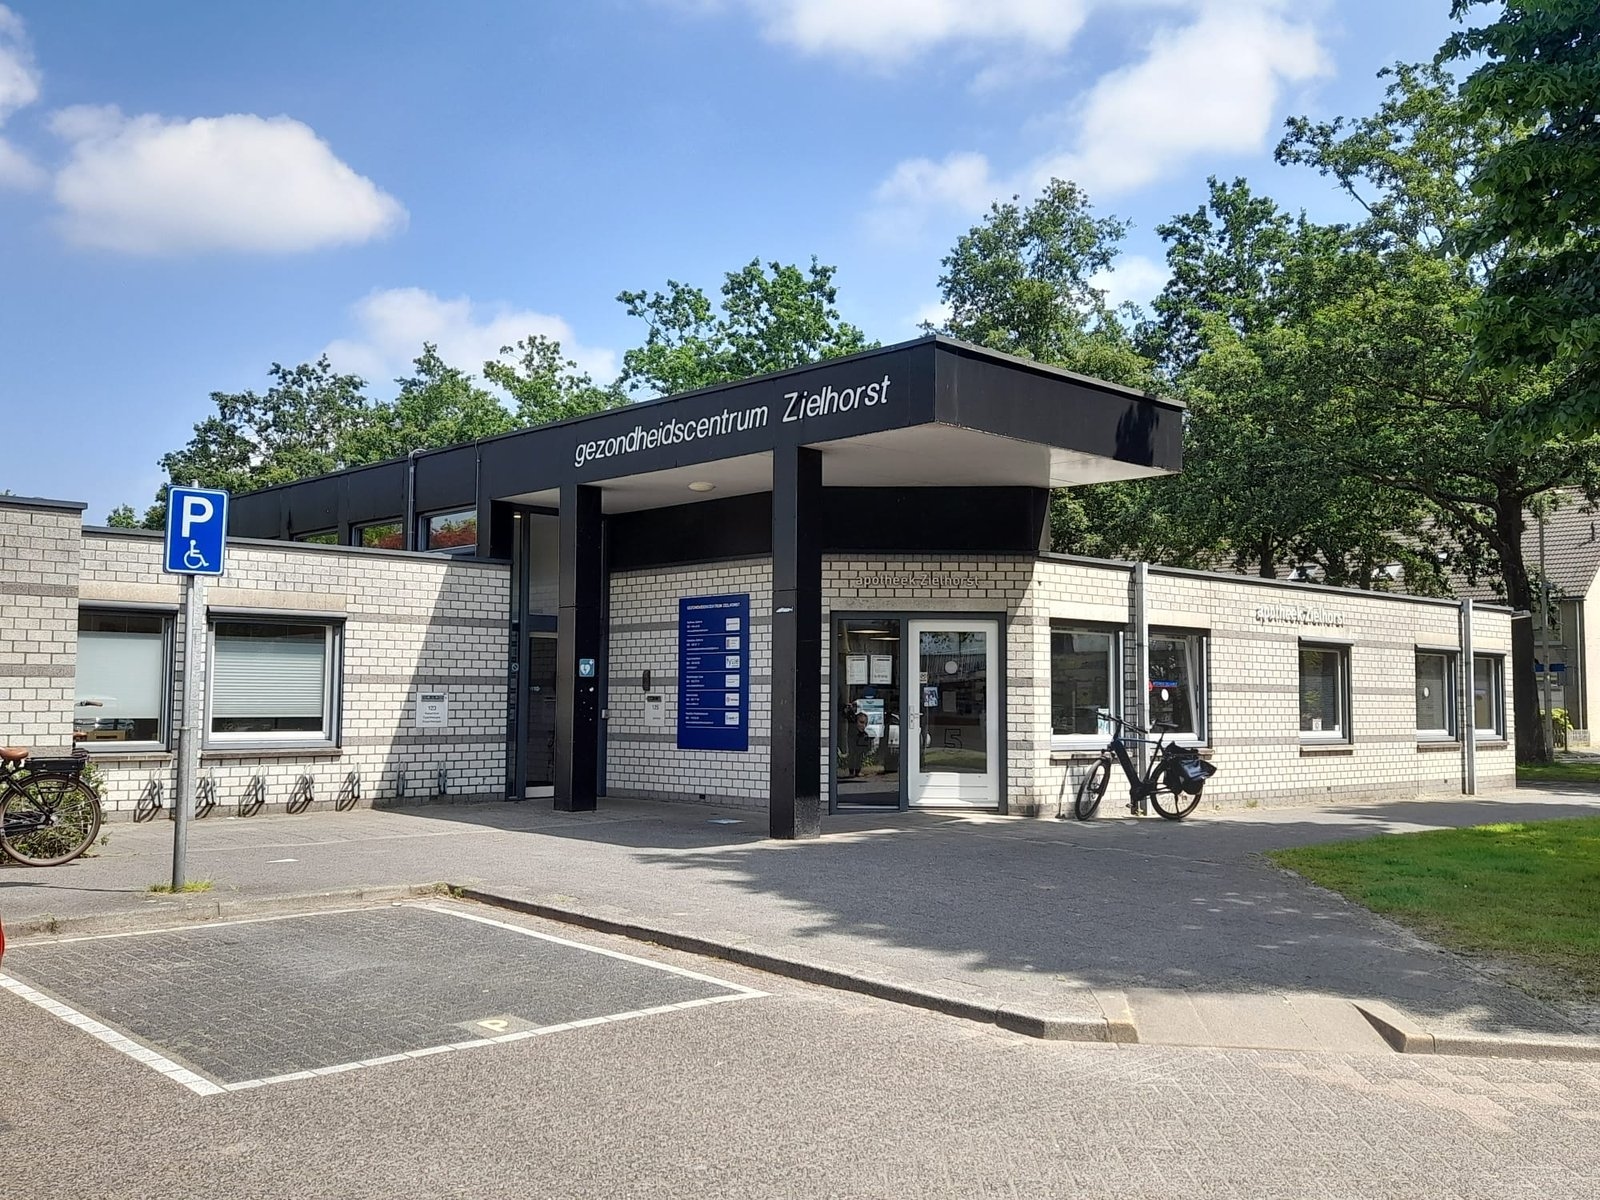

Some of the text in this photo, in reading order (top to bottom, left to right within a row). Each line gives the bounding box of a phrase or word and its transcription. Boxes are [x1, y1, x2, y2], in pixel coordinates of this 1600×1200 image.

[574, 375, 892, 468] gezondheidscentrum Zielhorst
[181, 495, 214, 538] P
[856, 573, 979, 589] apotheek Zielhorst
[1256, 603, 1345, 626] apotheek Zielhorst
[476, 1019, 508, 1032] P
